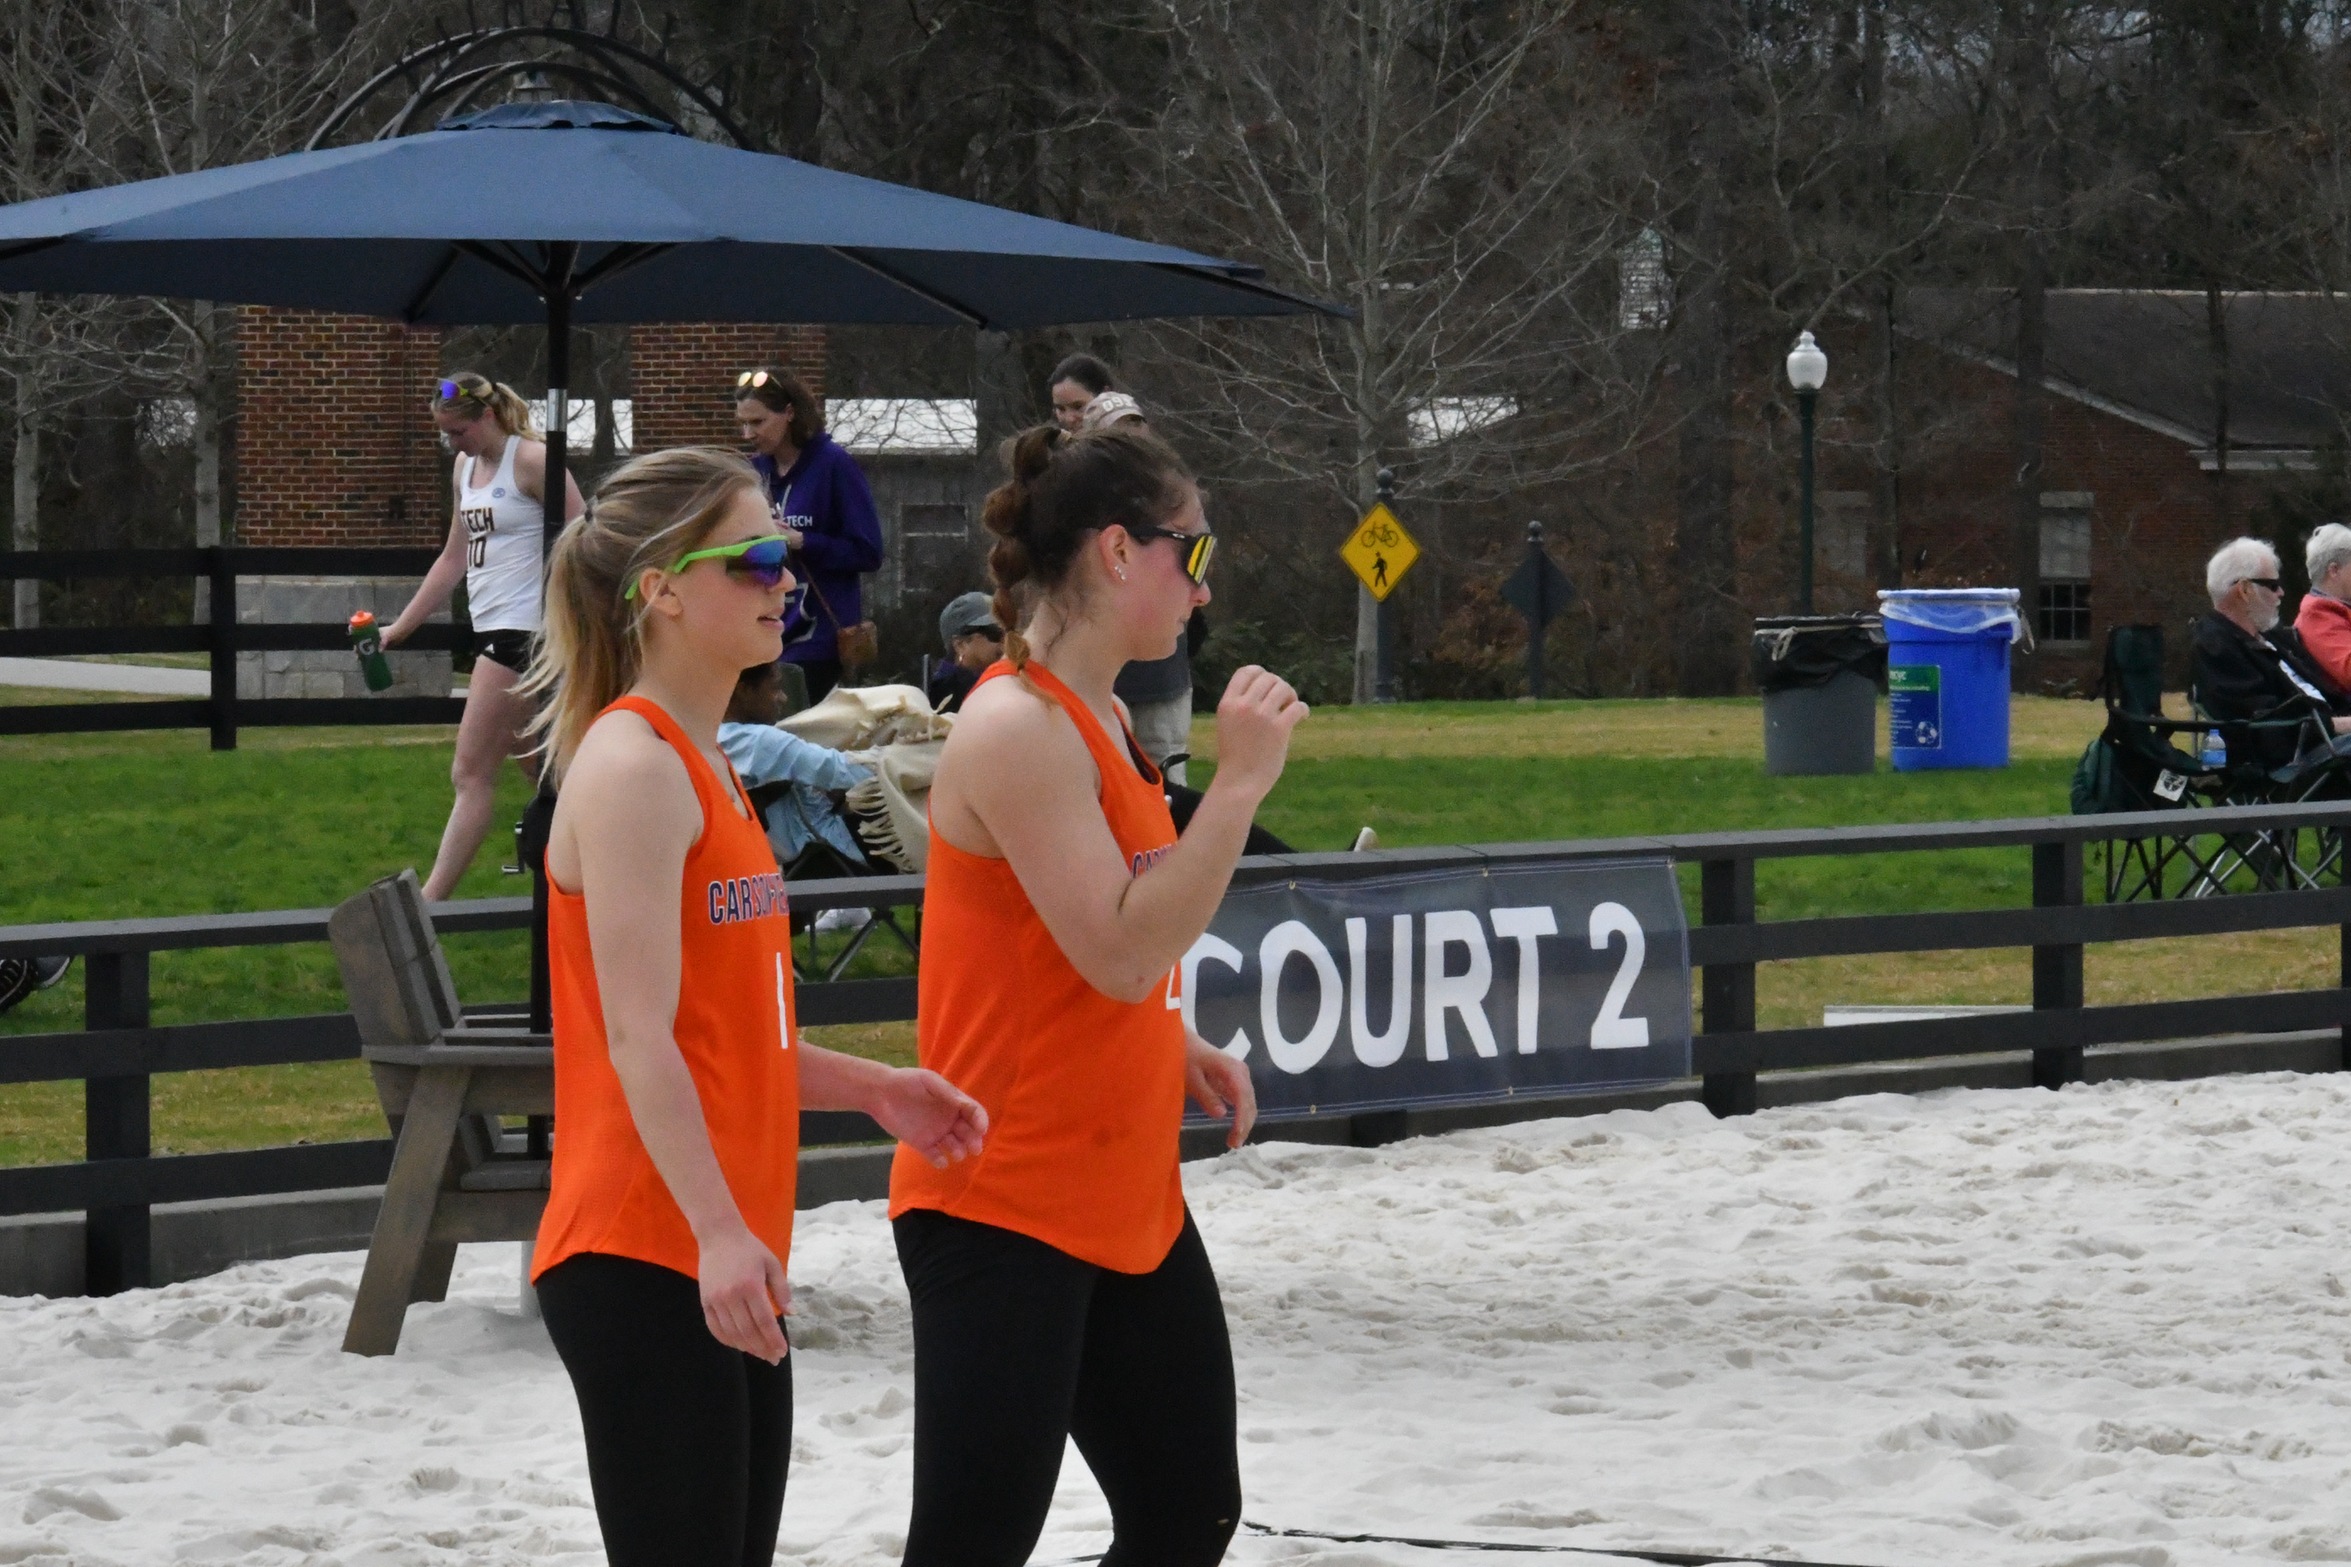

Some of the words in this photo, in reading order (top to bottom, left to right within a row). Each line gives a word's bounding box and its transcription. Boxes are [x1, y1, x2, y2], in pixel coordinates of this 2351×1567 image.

[786, 515, 813, 527] TECH
[469, 536, 486, 568] 10
[359, 638, 375, 655] G
[1180, 906, 1558, 1075] COURT
[1588, 901, 1650, 1050] 2
